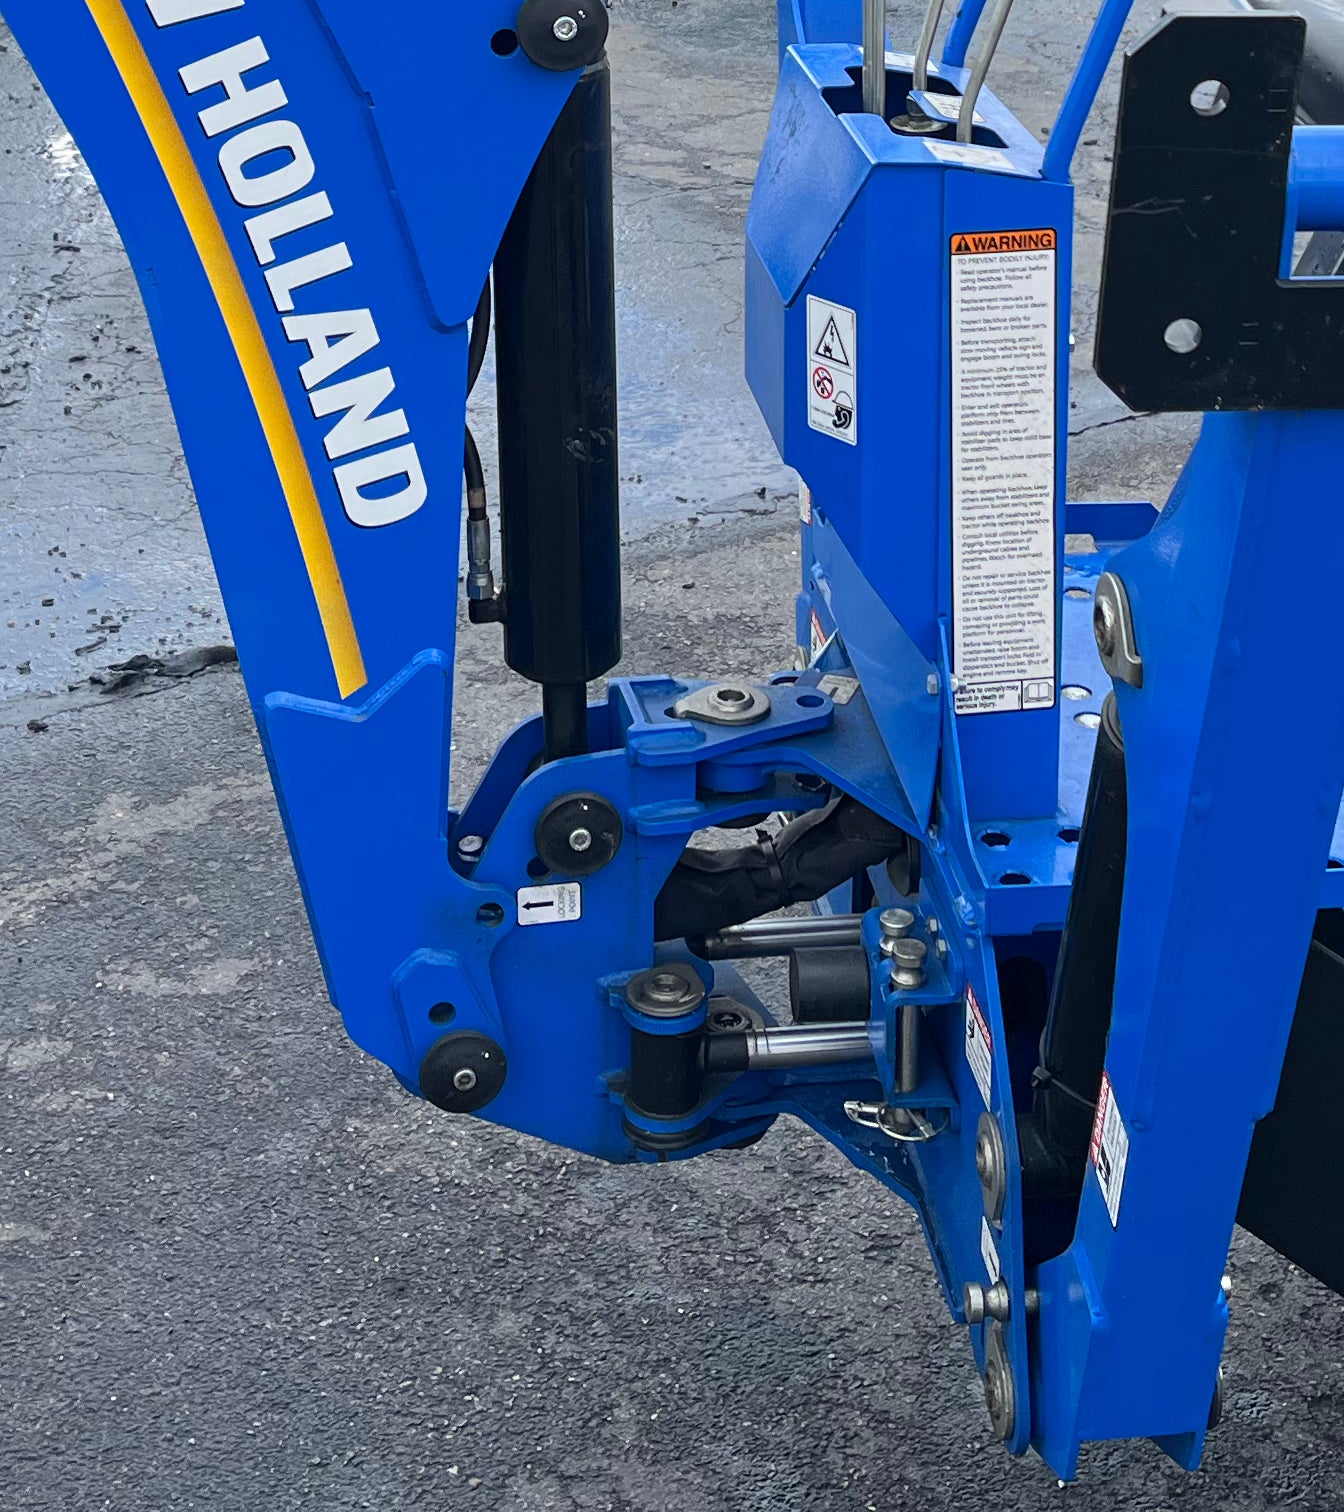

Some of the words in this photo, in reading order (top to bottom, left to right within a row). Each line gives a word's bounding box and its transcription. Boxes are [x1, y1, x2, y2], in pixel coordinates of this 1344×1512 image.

[972, 233, 1052, 250] WARNING
[177, 33, 429, 529] HOLLAND
[568, 890, 577, 913] POINT
